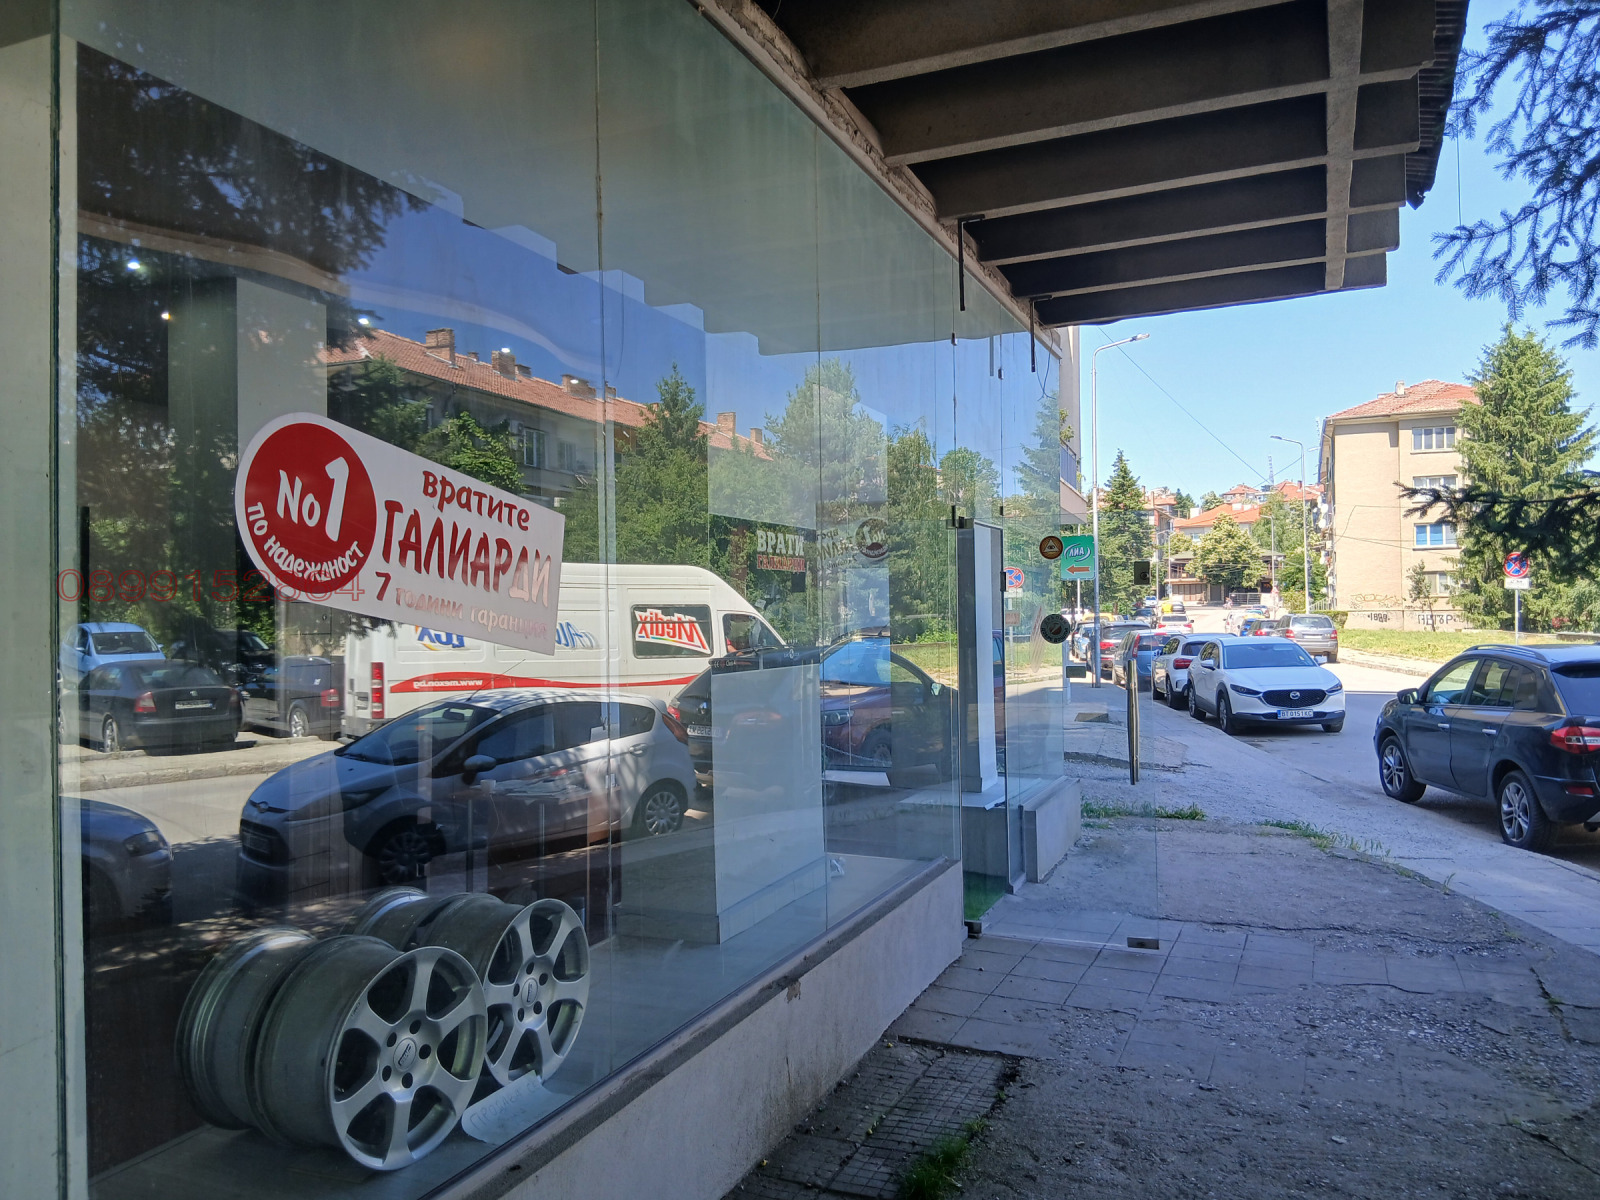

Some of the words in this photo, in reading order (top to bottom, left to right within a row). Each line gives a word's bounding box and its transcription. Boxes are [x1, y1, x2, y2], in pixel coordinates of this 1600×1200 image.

[422, 470, 530, 532] вратите
[381, 500, 551, 608] ГАЛИАРДИ
[756, 530, 805, 556] ВРАТИ
[375, 571, 392, 601] 7
